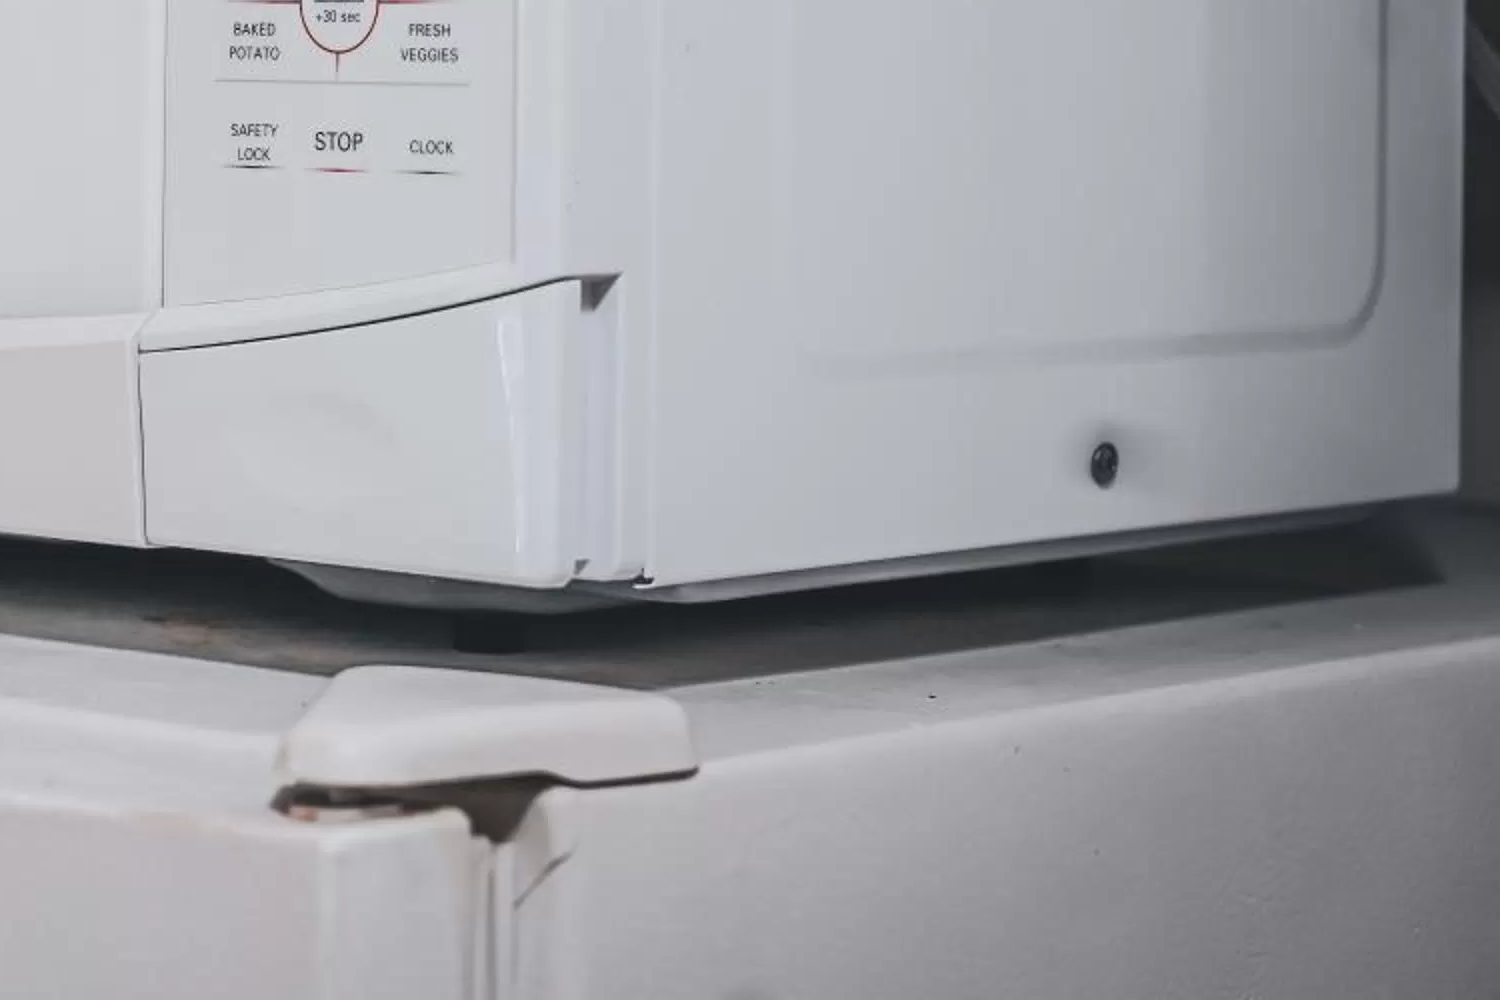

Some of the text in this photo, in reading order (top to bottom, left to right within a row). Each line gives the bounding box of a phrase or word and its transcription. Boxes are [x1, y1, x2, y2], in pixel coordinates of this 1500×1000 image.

[315, 9, 361, 24] +30 sec
[233, 22, 276, 37] BAKED
[408, 23, 451, 38] FRESH
[229, 46, 280, 61] POTATO
[400, 47, 459, 63] VEGGIES
[230, 123, 279, 138] SAFETY
[314, 131, 364, 152] STOP
[409, 139, 454, 155] CLOCK
[237, 147, 271, 162] LOCK
